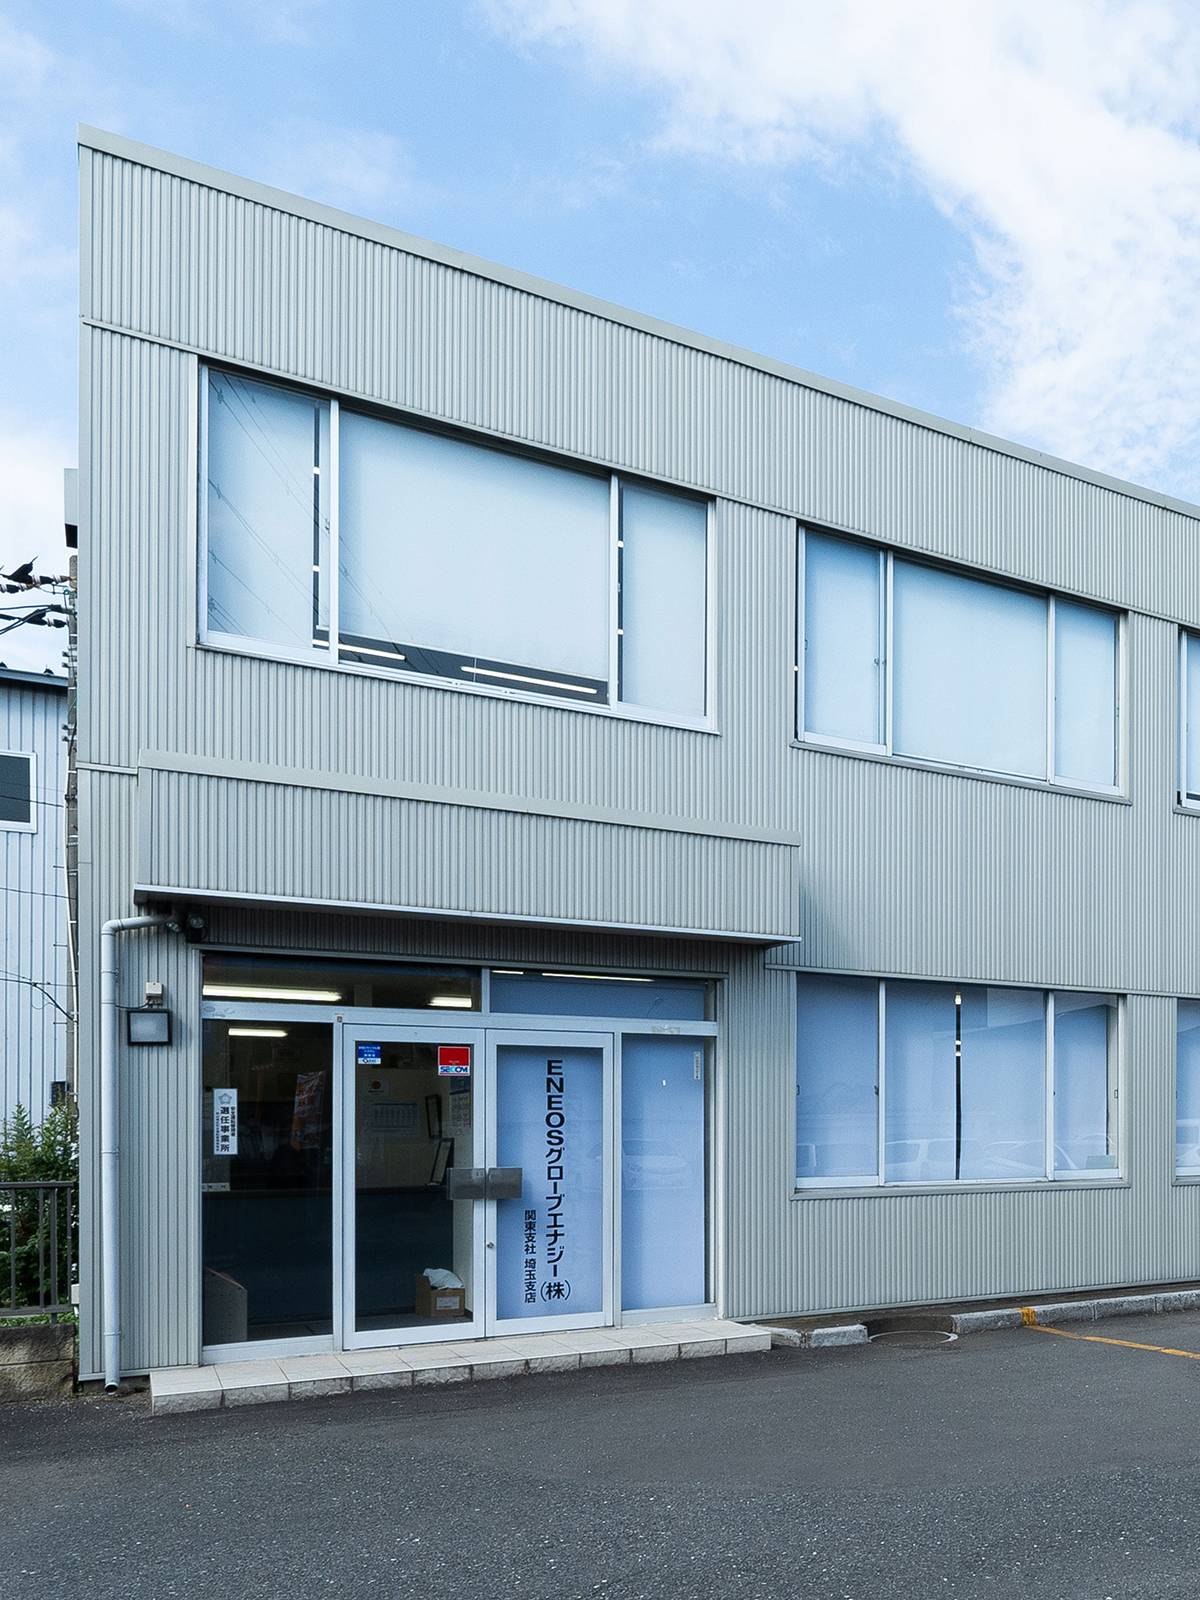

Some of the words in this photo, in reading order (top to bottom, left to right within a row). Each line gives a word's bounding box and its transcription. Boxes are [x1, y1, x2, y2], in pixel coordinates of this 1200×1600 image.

[220, 1106, 230, 1152] 選任事業所
[524, 1209, 536, 1255] 関東支社
[524, 1258, 536, 1303] 埼玉支店
